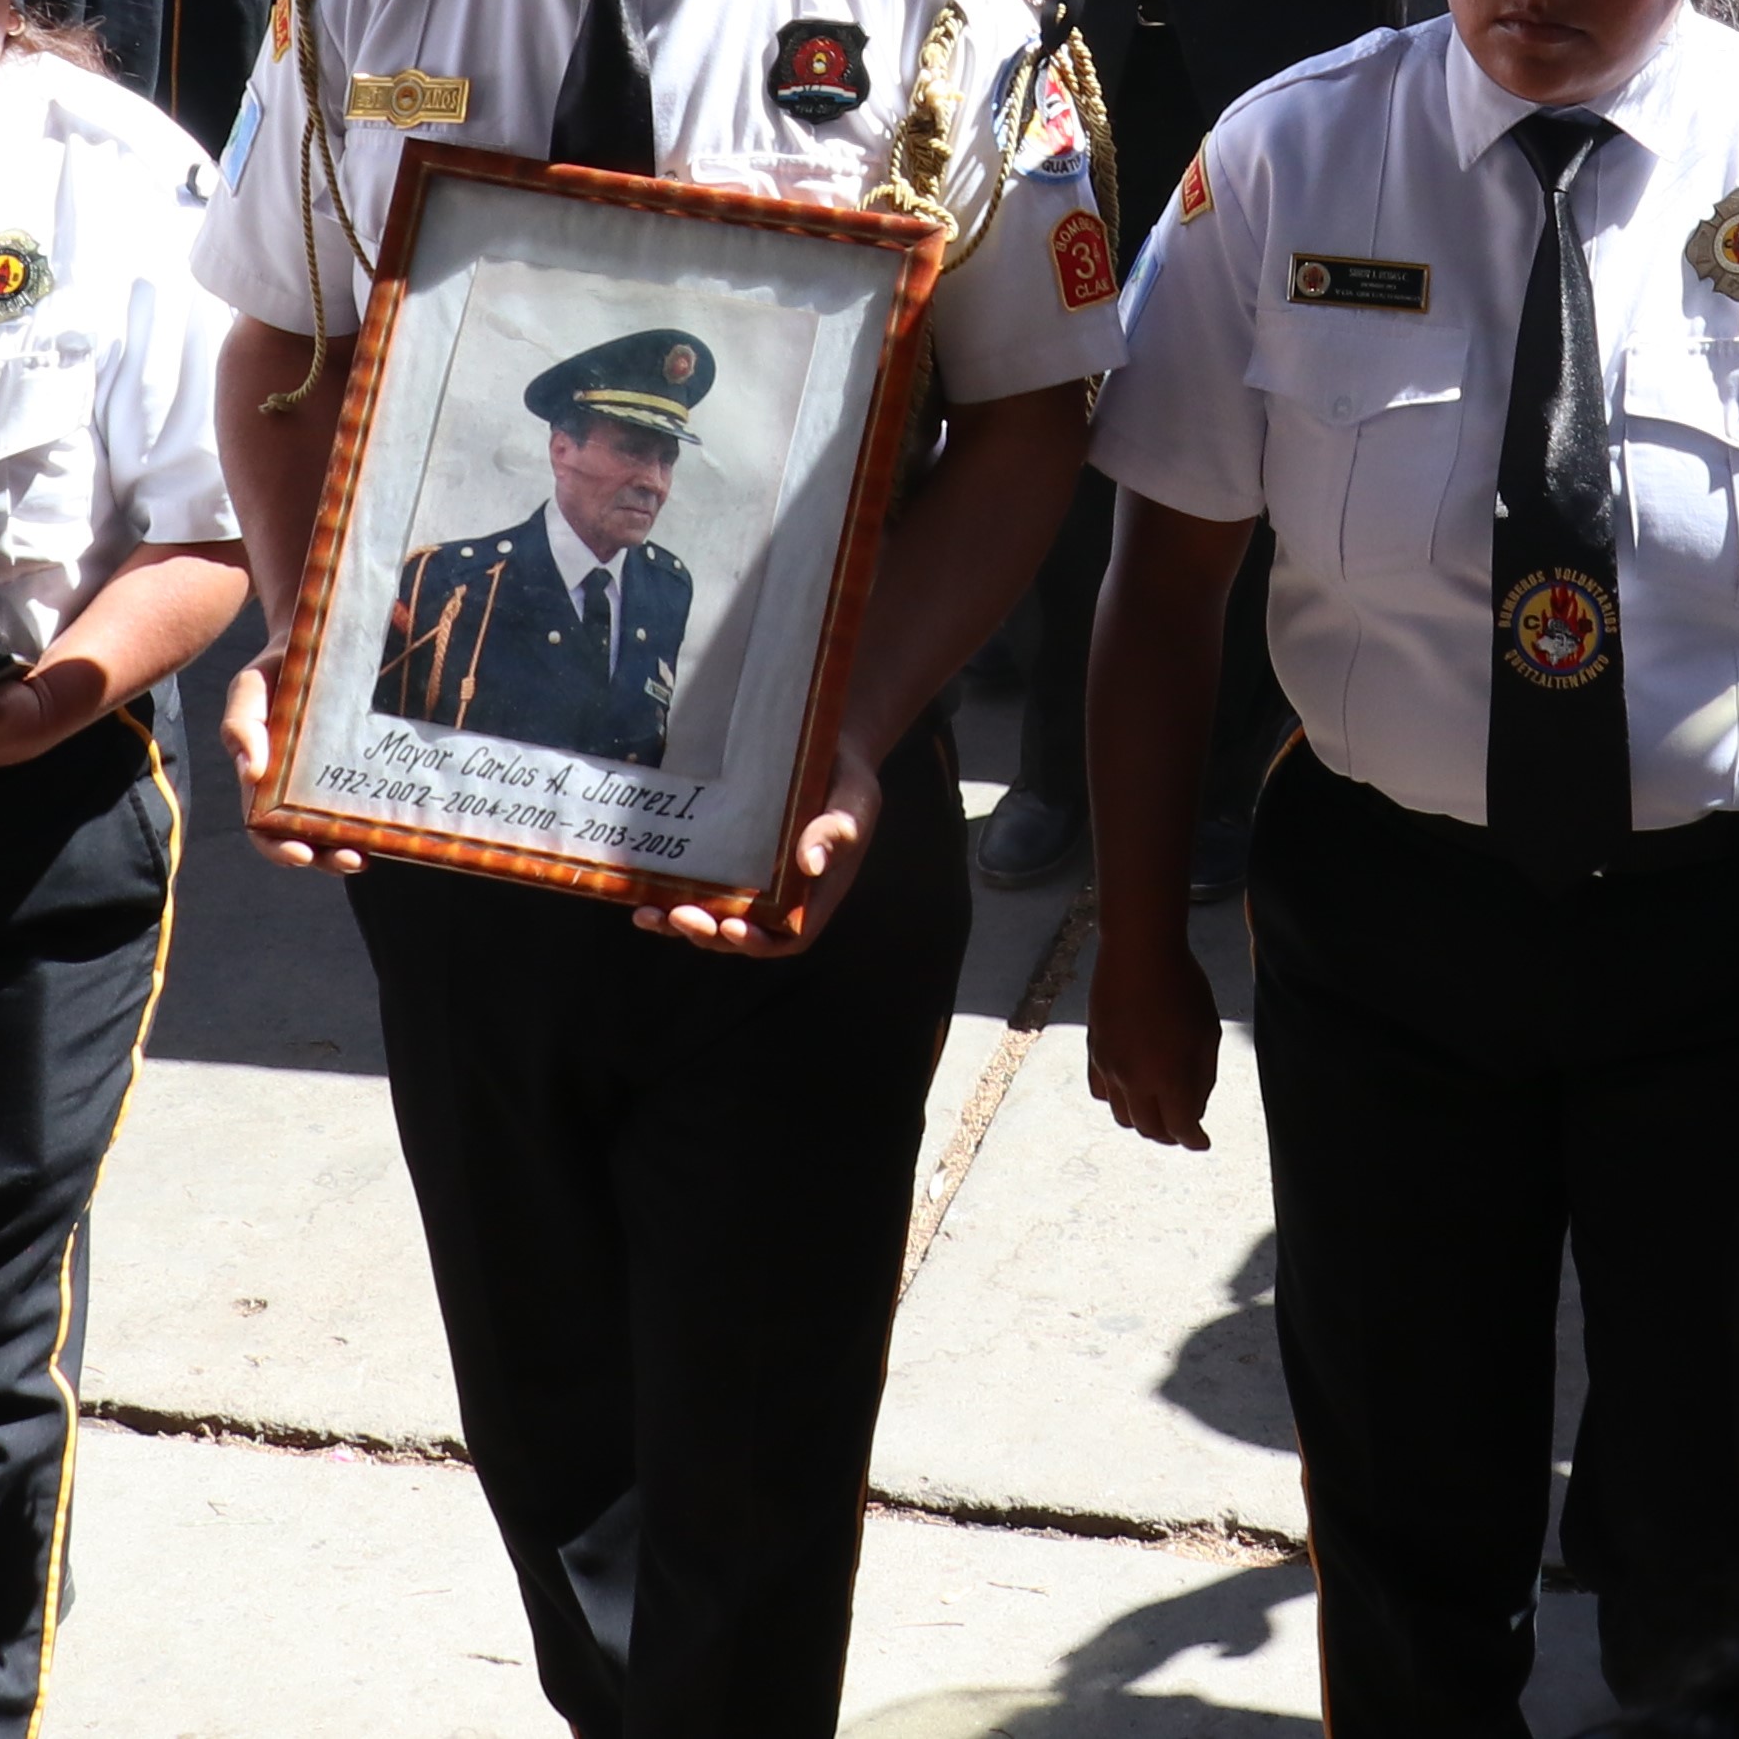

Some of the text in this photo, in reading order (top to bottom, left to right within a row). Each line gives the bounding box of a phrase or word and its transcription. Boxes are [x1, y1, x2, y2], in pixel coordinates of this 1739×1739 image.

[1553, 566, 1618, 634] VOLUNTARIOS
[1503, 648, 1610, 690] QUETZALTENANGO
[364, 729, 453, 774] Mayor
[461, 746, 539, 789] Carlos
[544, 763, 568, 797] A.
[582, 770, 678, 817] Juarez
